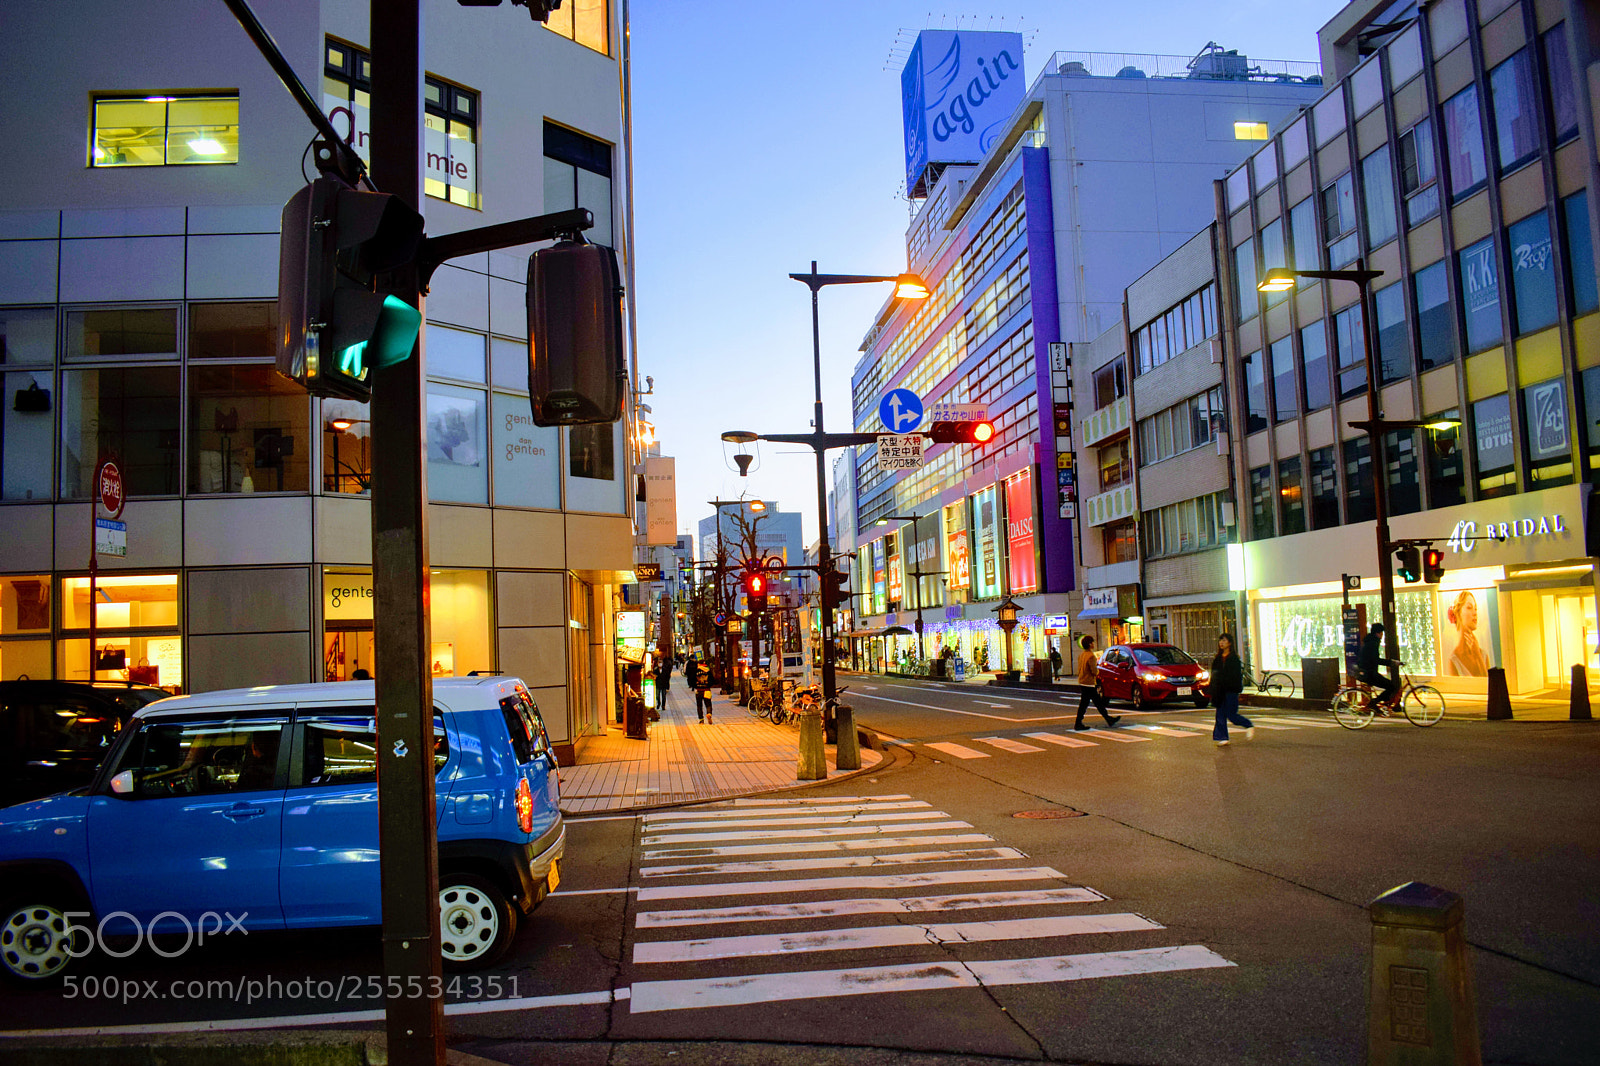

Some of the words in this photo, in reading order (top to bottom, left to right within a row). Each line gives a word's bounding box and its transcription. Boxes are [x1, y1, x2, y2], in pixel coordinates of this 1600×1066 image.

[933, 50, 1018, 142] again
[506, 414, 535, 431] gent
[506, 443, 546, 461] genten
[103, 477, 120, 499] 消火栓
[1486, 514, 1565, 541] BRIDAL
[332, 586, 373, 608] gente
